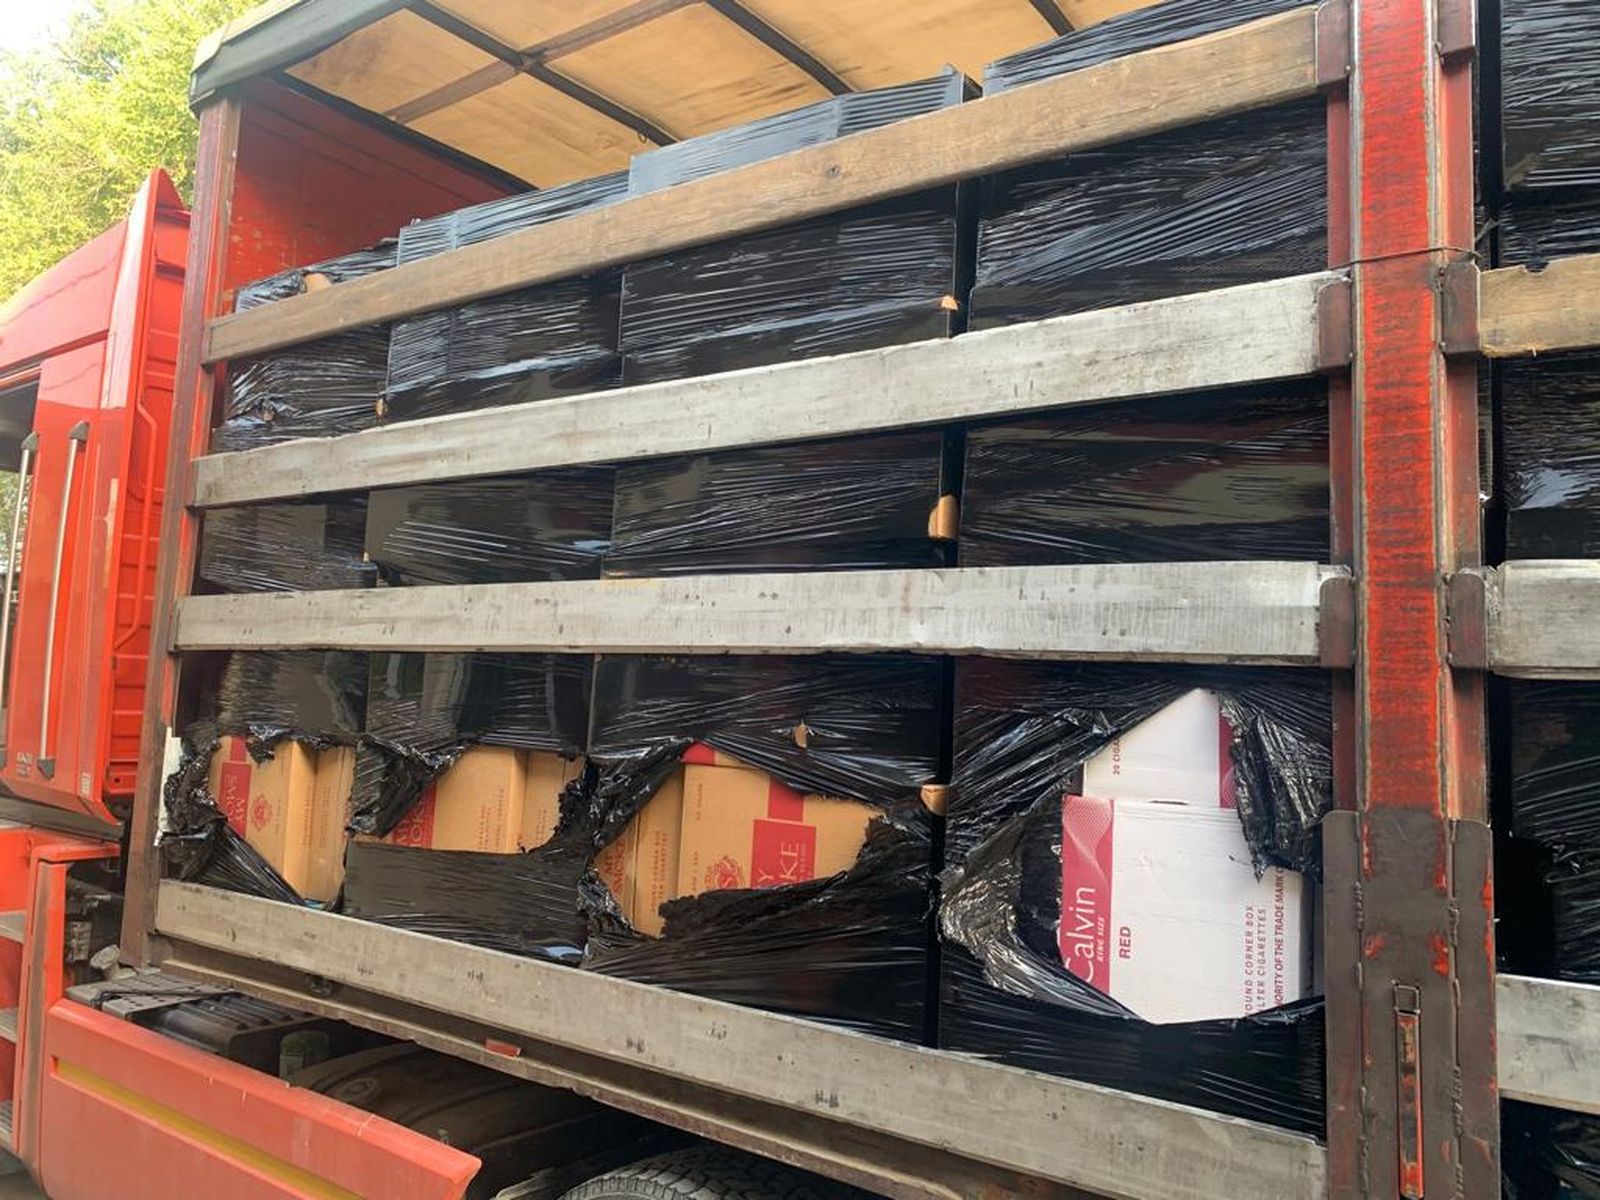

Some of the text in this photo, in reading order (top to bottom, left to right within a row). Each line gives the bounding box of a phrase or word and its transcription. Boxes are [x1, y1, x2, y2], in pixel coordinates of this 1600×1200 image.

[1244, 905, 1254, 927] BOX
[1118, 926, 1131, 960] RED
[1244, 930, 1254, 976] CORNER
[1257, 907, 1267, 977] CIGARETTES
[1274, 937, 1284, 958] THE
[1274, 958, 1284, 972] OF
